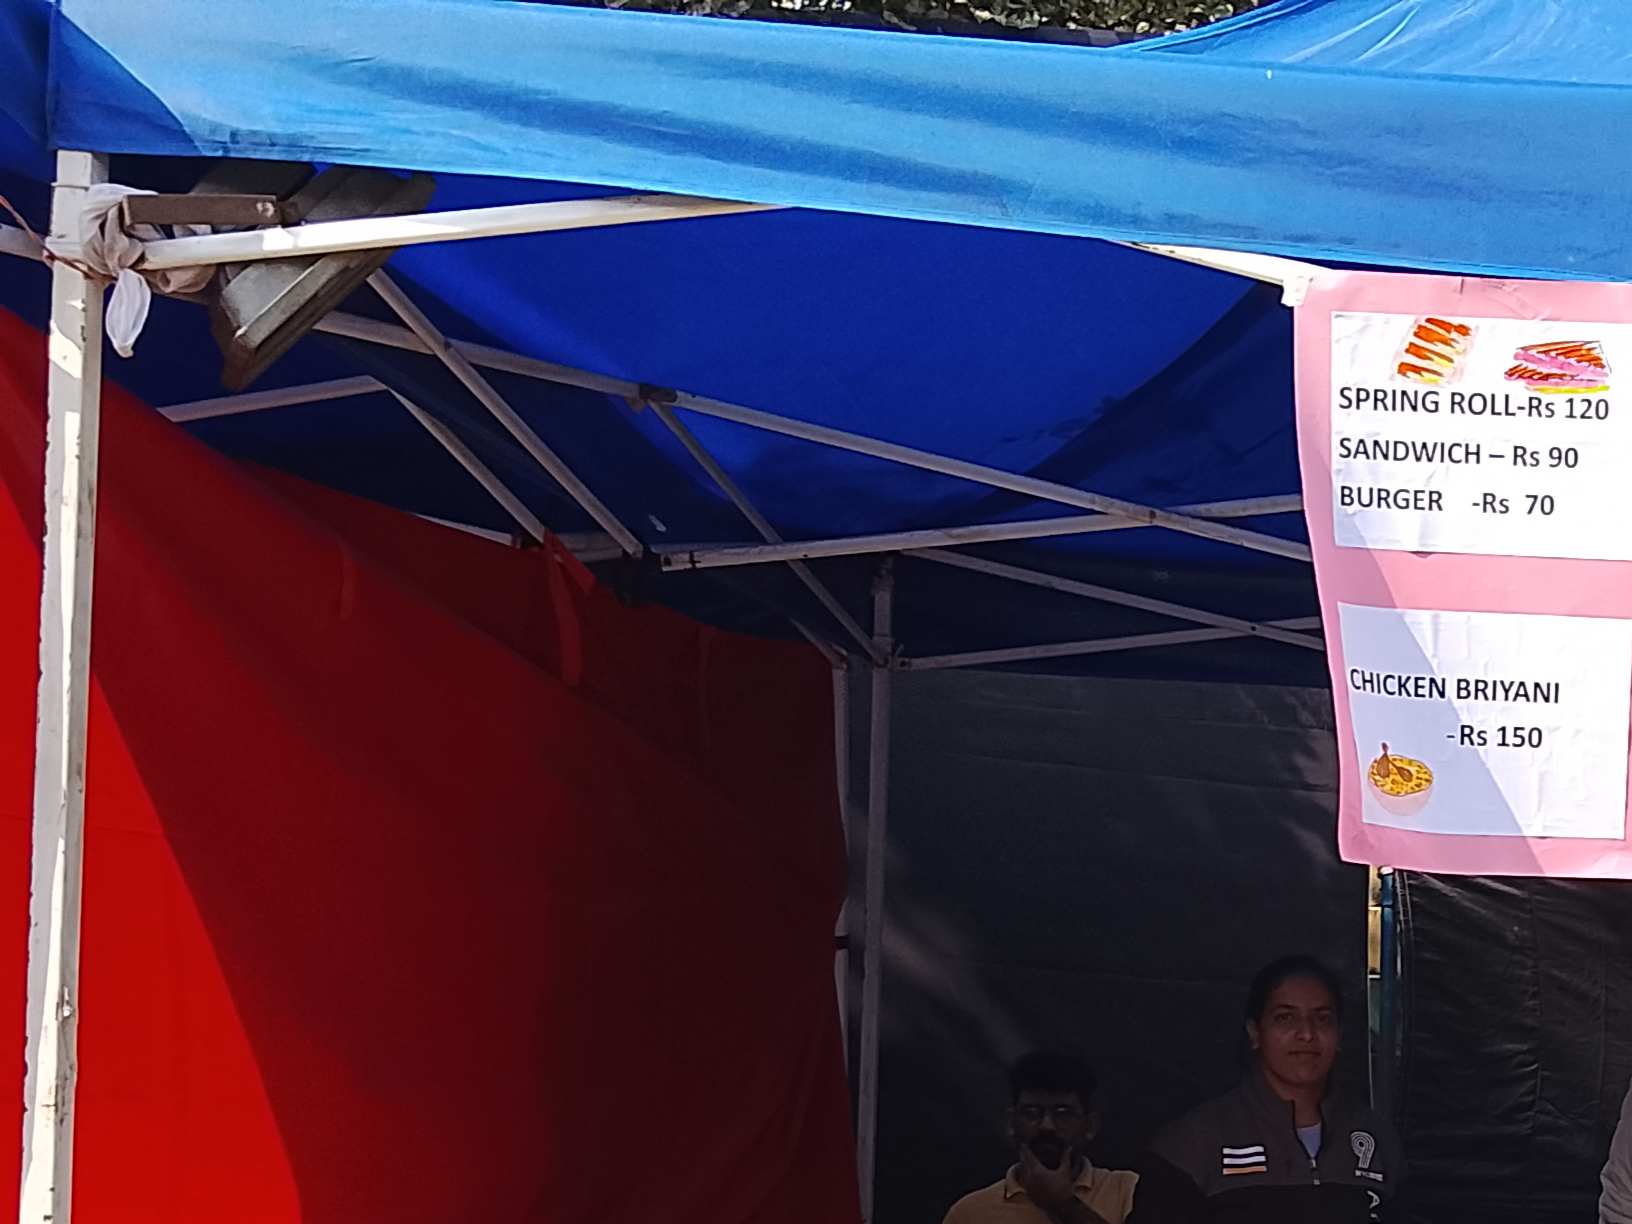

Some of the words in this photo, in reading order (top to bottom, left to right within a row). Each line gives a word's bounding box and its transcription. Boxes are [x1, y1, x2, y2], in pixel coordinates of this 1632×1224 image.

[1338, 387, 1440, 413] SPRING
[1565, 398, 1610, 420] 120
[1338, 437, 1481, 465] SANDWICH
[1512, 445, 1540, 467] Rs
[1549, 447, 1579, 468] 90
[1340, 485, 1444, 511] BURGER
[1472, 492, 1510, 514] -Rs
[1525, 494, 1555, 515] 70
[1350, 668, 1447, 699] CHICKEN
[1456, 678, 1560, 704] BRIYANI
[1446, 724, 1488, 746] -Rs
[1496, 726, 1543, 748] 150
